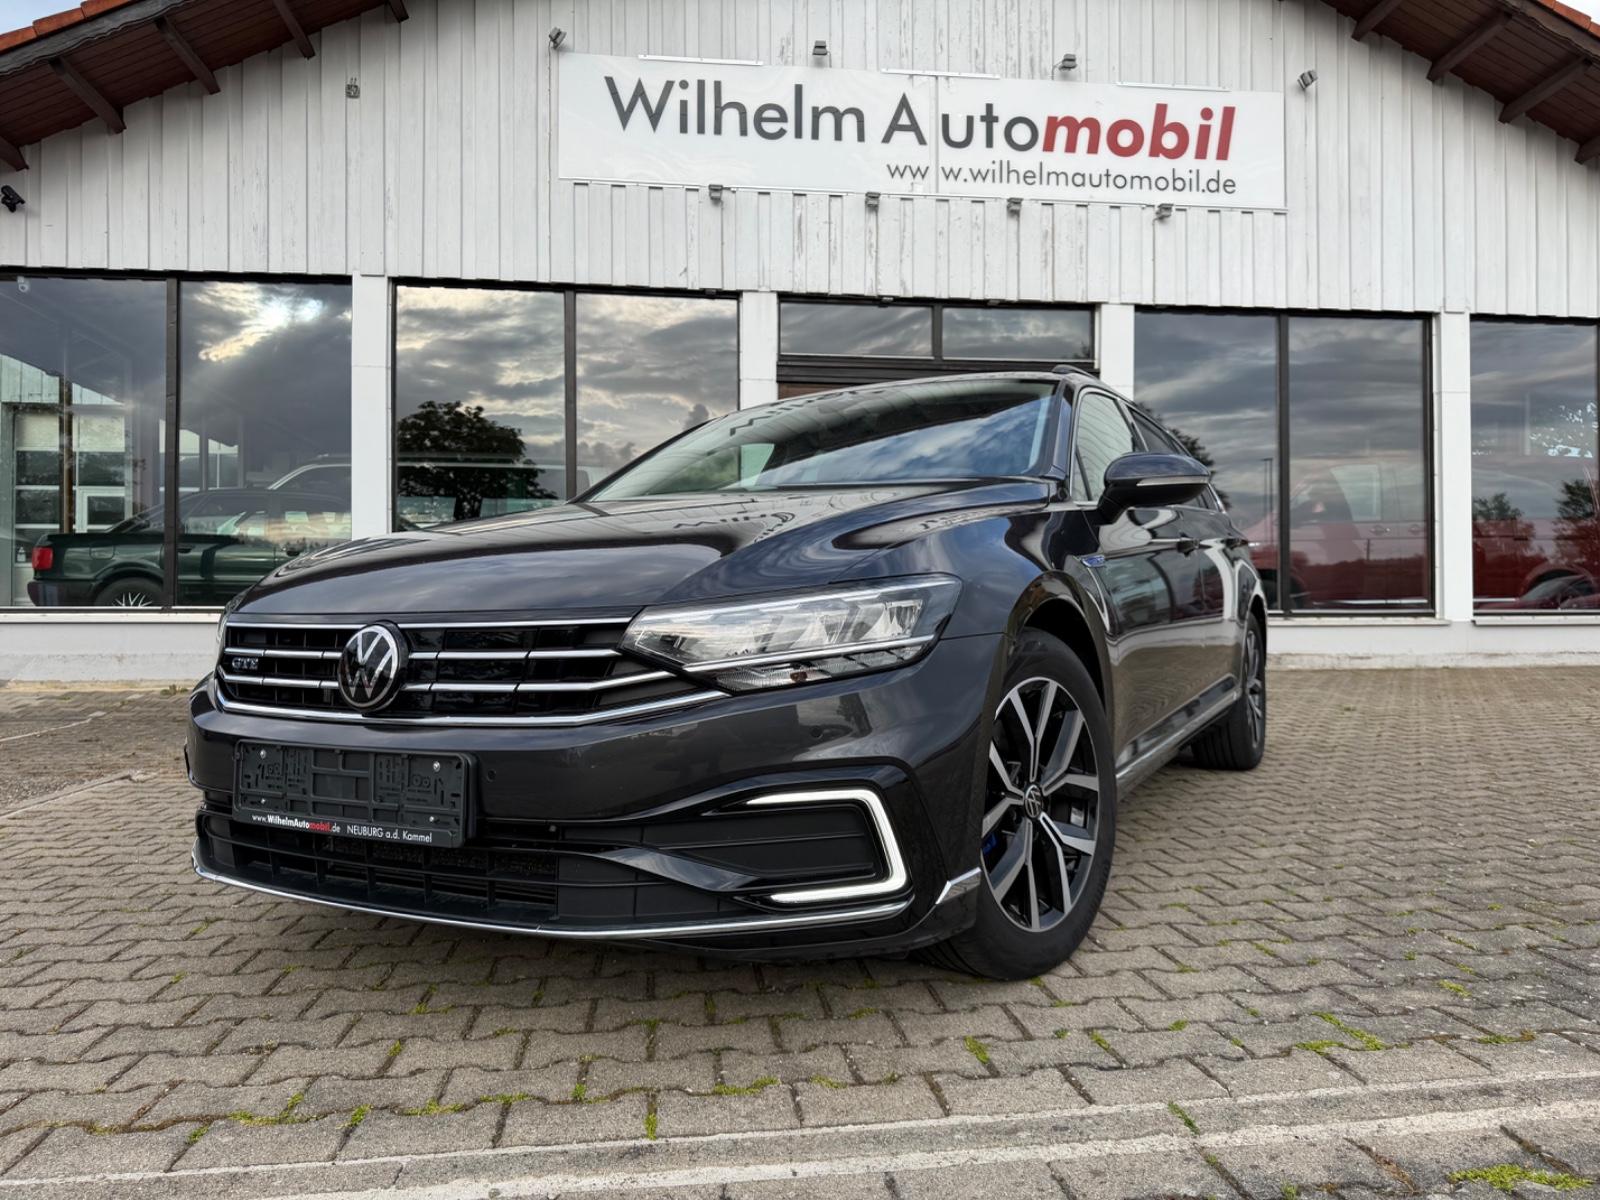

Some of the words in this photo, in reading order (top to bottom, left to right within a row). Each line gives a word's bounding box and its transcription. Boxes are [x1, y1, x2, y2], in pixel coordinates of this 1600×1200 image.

[604, 76, 866, 143] Wilhelm
[881, 92, 1236, 161] Automobil
[886, 160, 1236, 194] www.wilhelmautomobil.de
[346, 825, 384, 838] NEUBURG
[385, 828, 400, 839] a.d.
